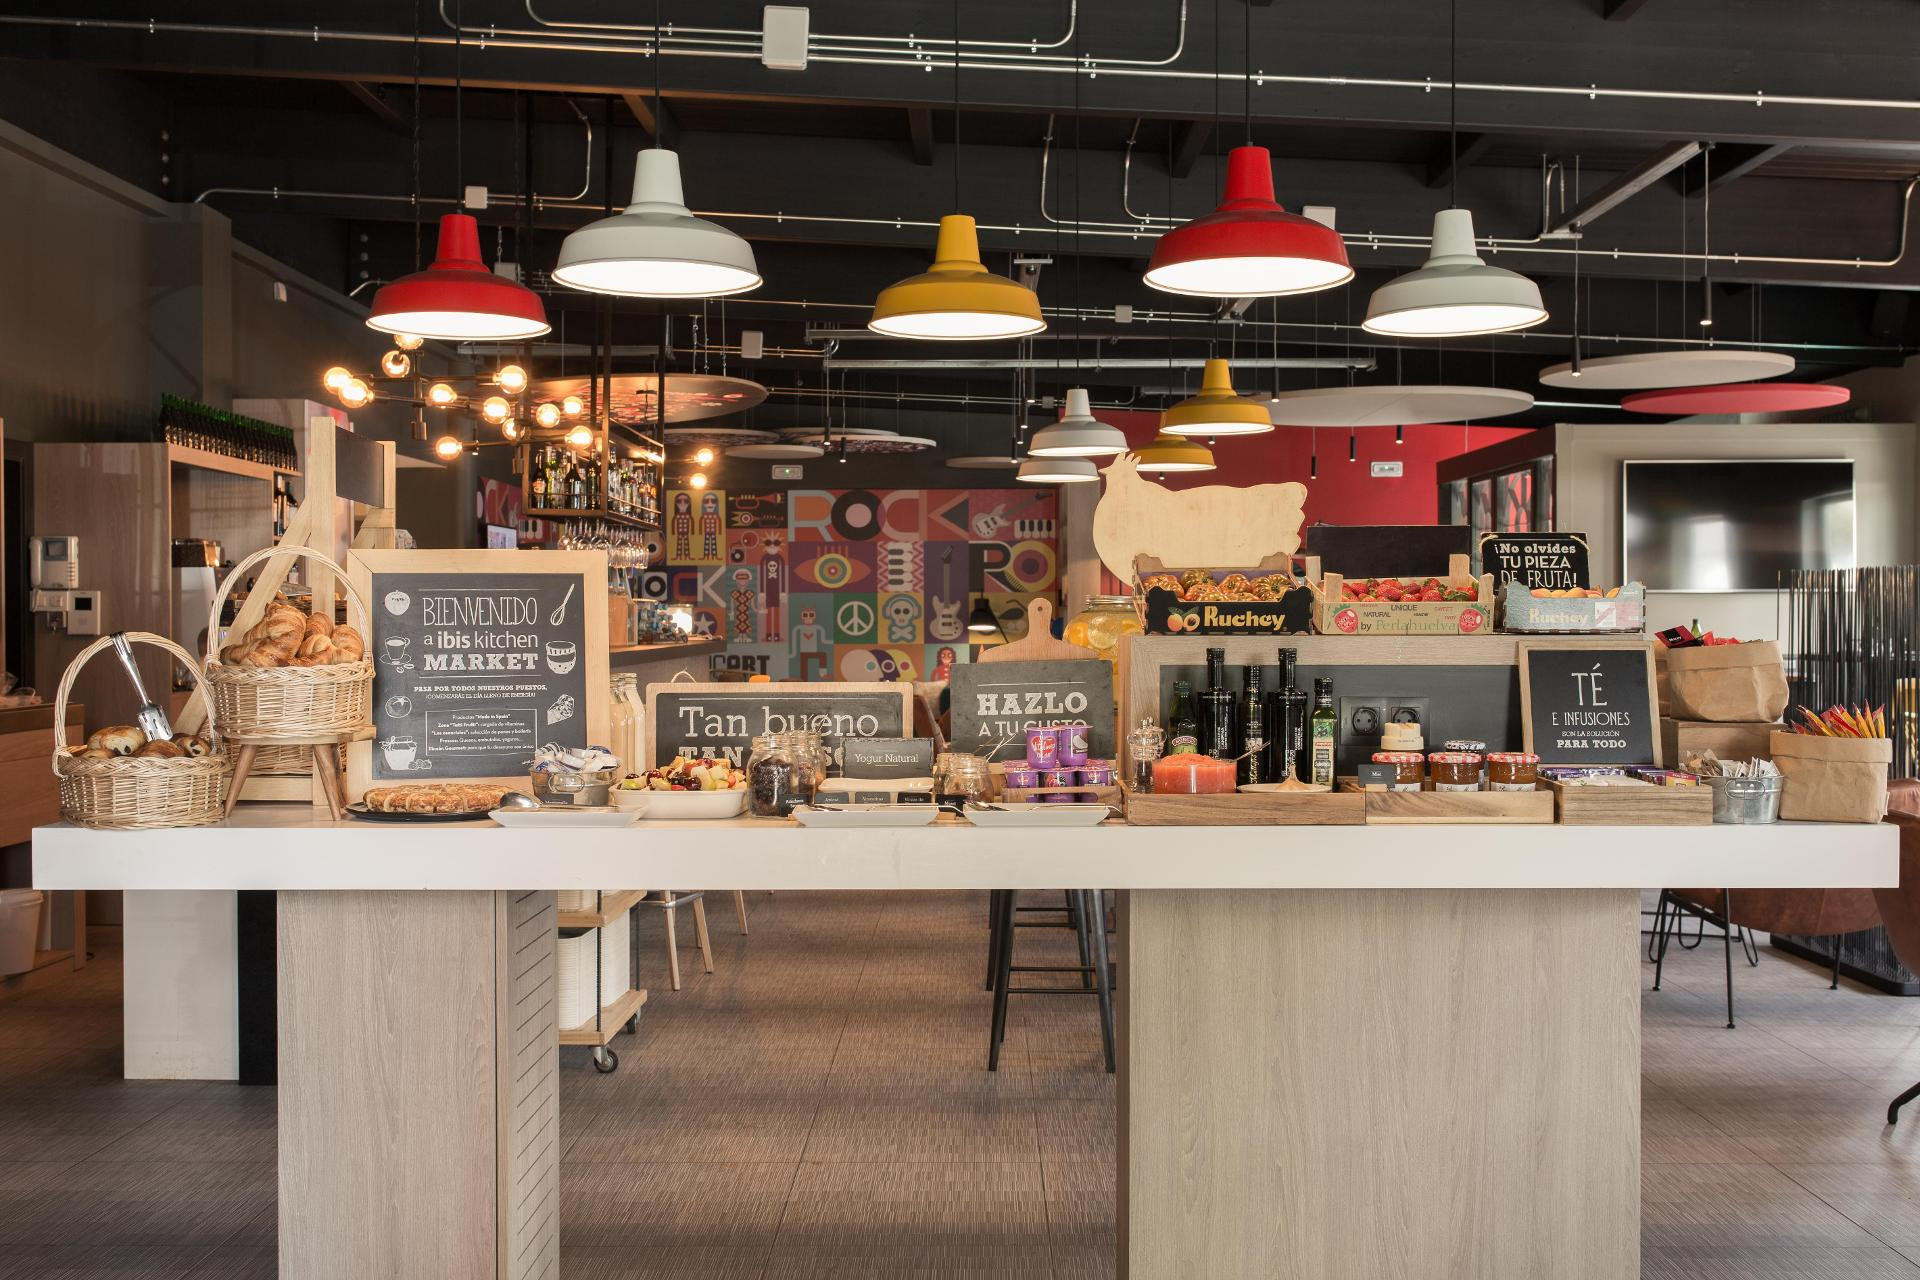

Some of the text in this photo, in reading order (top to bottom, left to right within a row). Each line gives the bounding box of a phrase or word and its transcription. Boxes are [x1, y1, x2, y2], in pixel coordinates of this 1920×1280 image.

[788, 490, 969, 542] ROCK
[1494, 543, 1576, 554] ¡No olvides
[1500, 556, 1571, 568] TU PIEZA
[1528, 570, 1577, 588] FRUTA!
[422, 596, 538, 626] BIENVENIDO
[1204, 606, 1286, 630] Ruchey
[1361, 621, 1372, 632] by
[424, 630, 538, 648] a ibis kitchen
[424, 653, 538, 670] MARKET
[1571, 662, 1608, 706] TÉ
[977, 692, 1088, 715] HAZLO
[679, 706, 879, 737] Tan bueno
[1552, 712, 1630, 726] E INFUSIONES
[978, 722, 992, 736] A
[995, 721, 1019, 736] TU
[1557, 740, 1626, 748] PARA TODO
[854, 754, 919, 764] Yogur Natural
